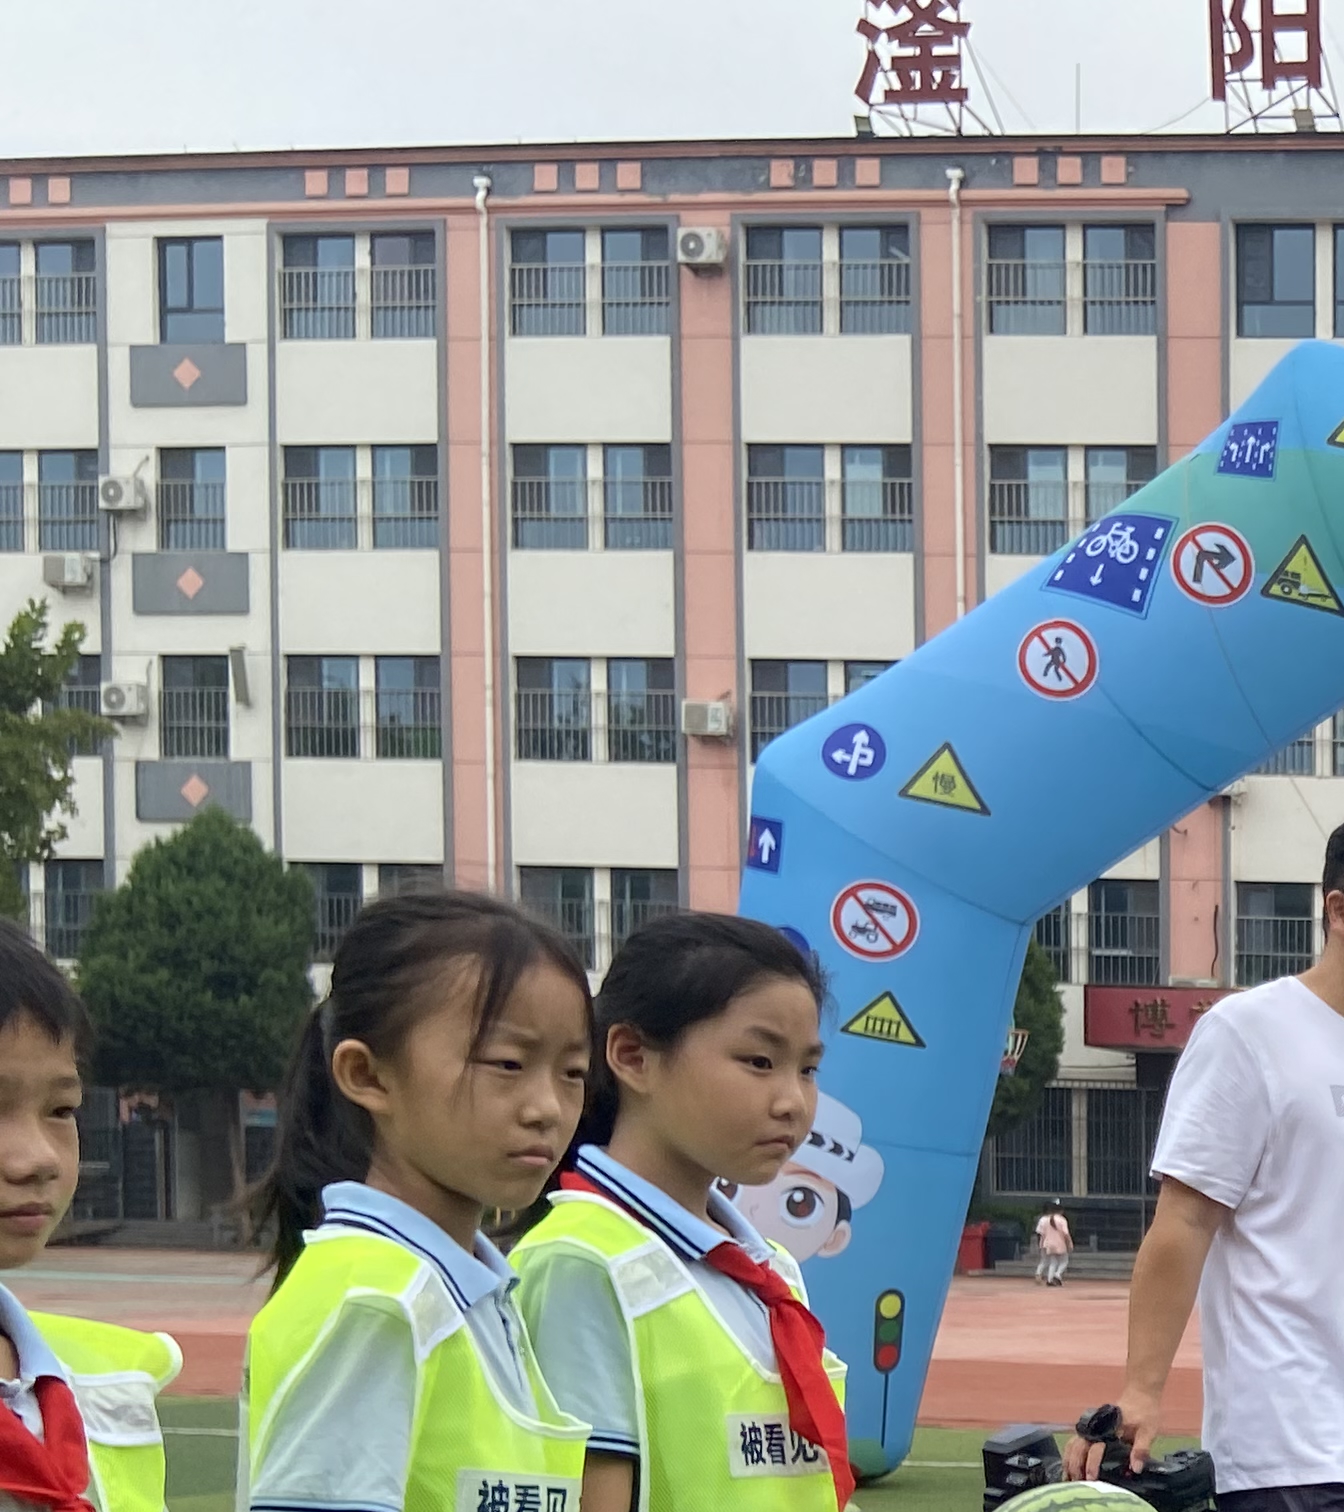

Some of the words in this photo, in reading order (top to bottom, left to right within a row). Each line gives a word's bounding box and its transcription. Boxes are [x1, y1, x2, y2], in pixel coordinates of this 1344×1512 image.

[932, 772, 957, 797] 慢
[740, 1421, 819, 1466] 被看见
